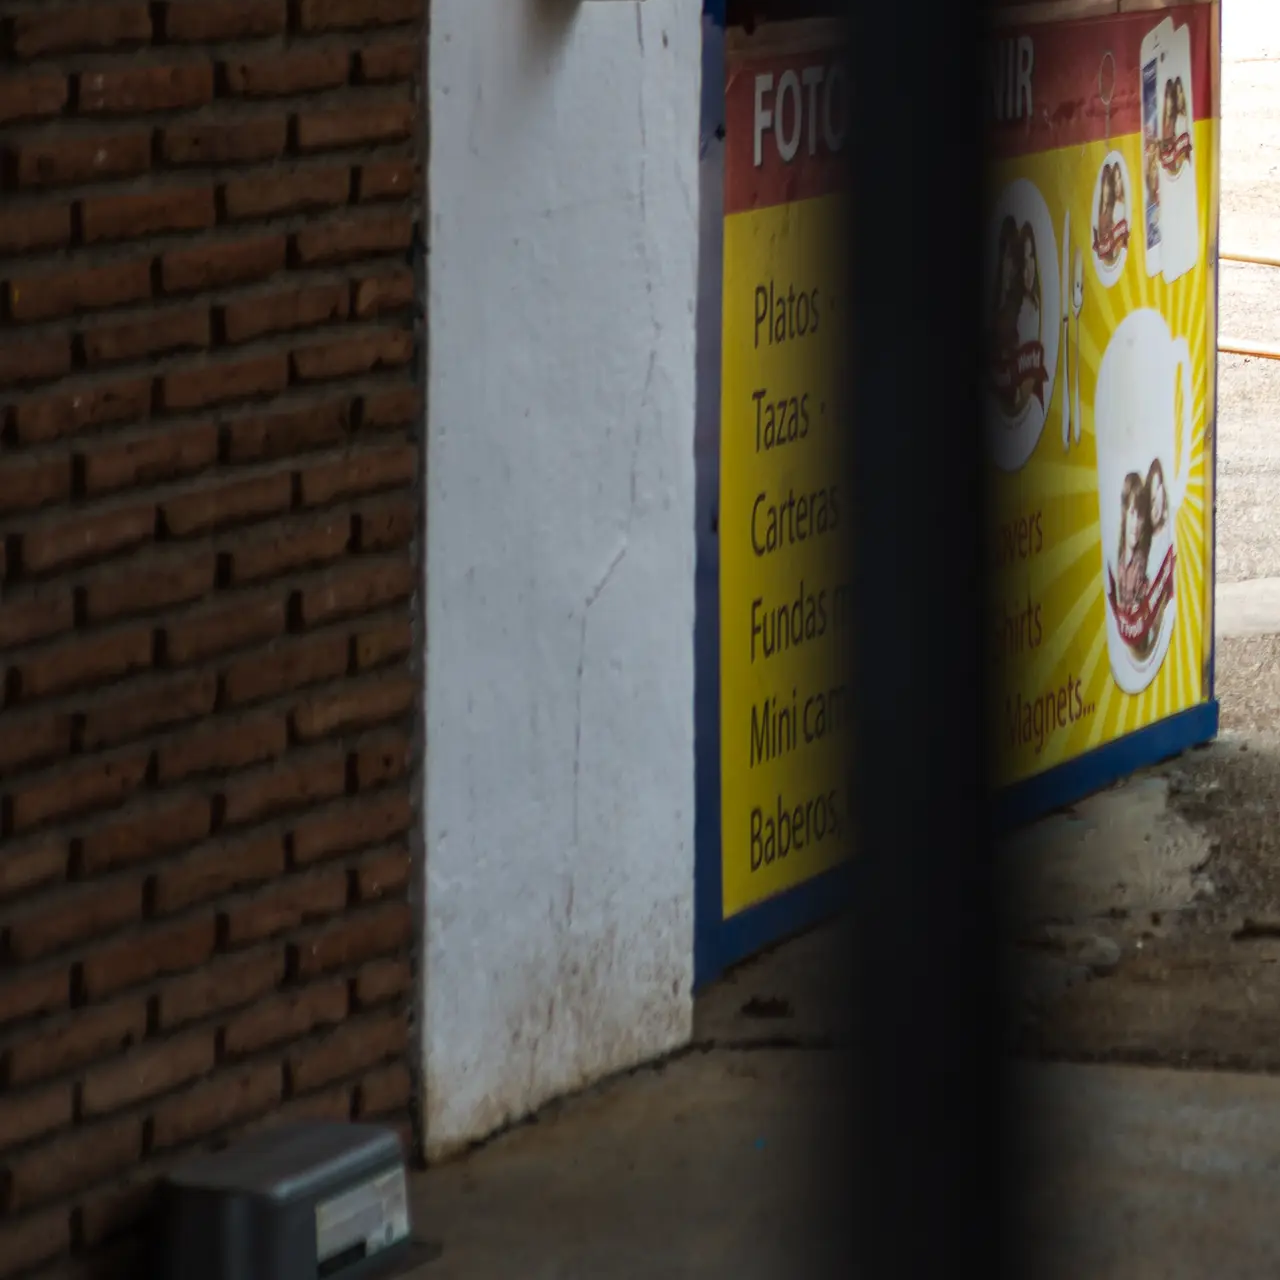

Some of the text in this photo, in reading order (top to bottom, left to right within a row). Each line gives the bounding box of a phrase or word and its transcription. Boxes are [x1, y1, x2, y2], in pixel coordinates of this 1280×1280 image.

[753, 66, 849, 167] FOTO
[754, 279, 821, 349] Platos
[752, 387, 810, 454] Tazas
[749, 488, 840, 558] Carteras
[750, 580, 828, 665] Fundas
[749, 689, 798, 769] Mini
